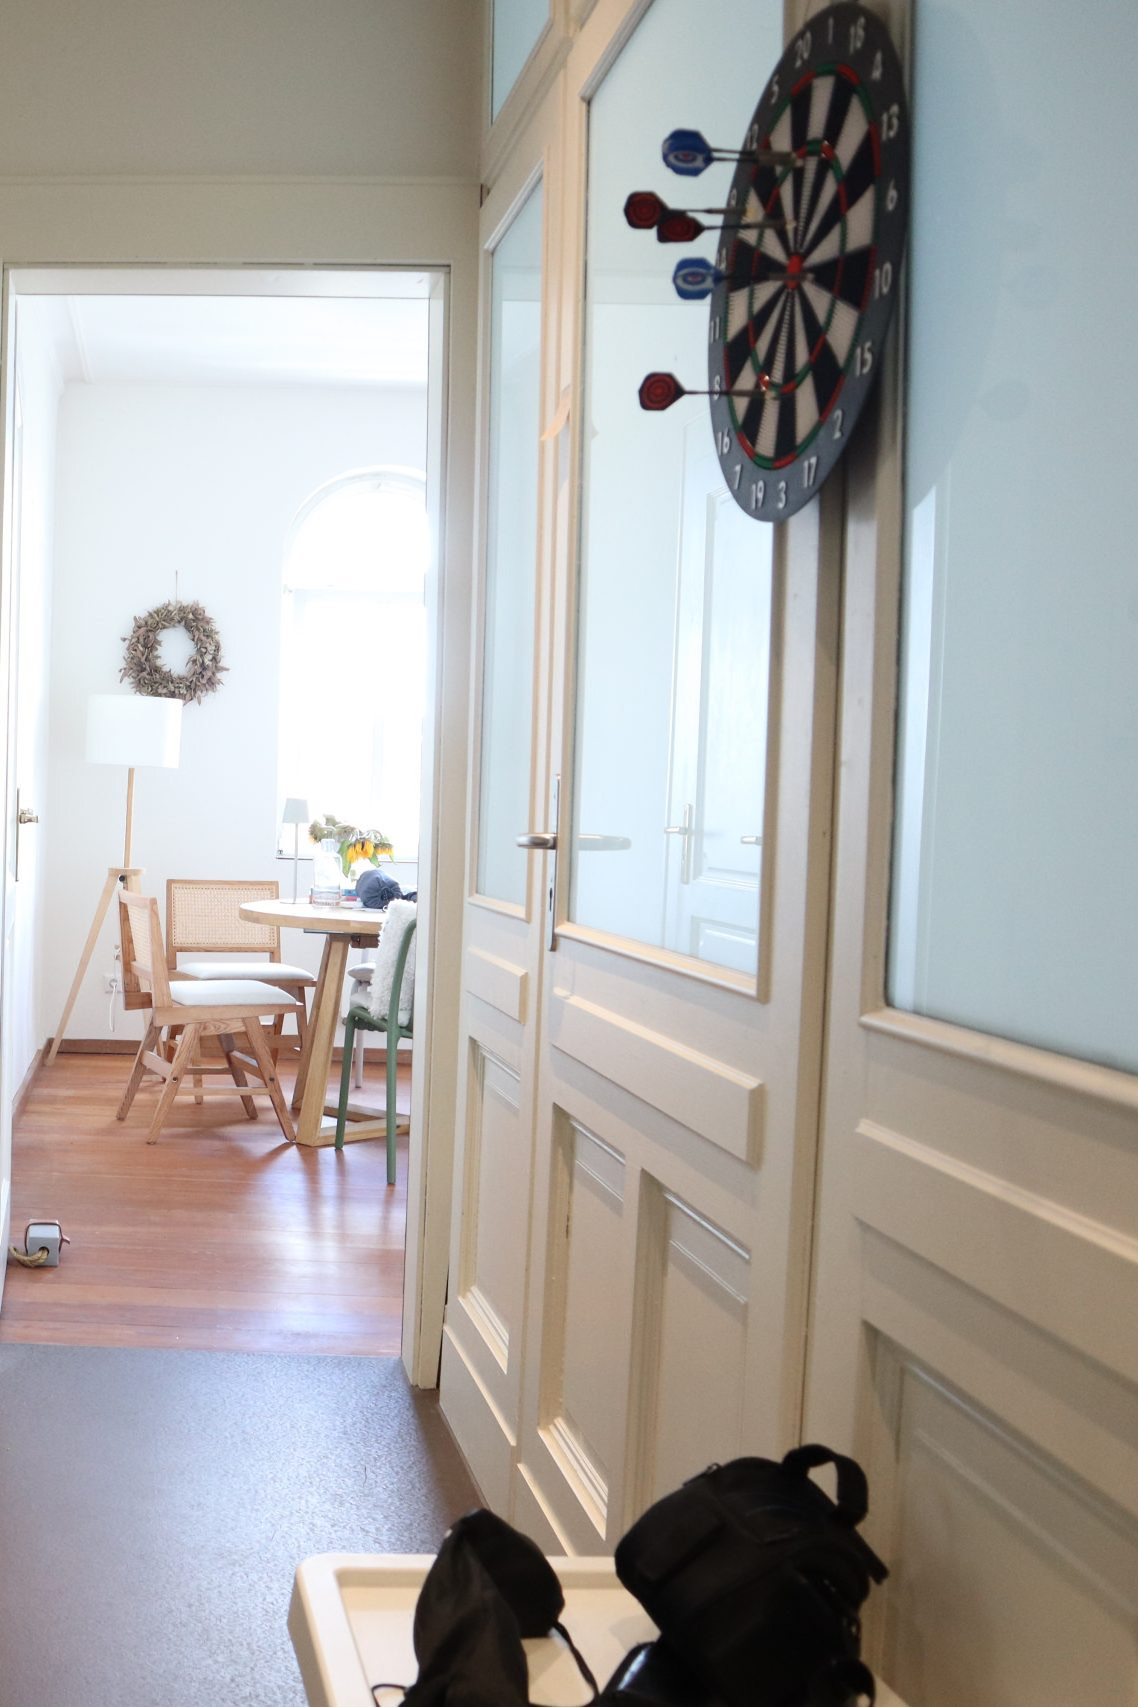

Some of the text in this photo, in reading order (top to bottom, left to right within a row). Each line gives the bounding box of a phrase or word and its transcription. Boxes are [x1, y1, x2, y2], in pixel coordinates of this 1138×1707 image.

[828, 16, 834, 44] 1
[795, 29, 812, 69] 20
[871, 50, 882, 80] 4
[771, 75, 779, 103] 5
[886, 178, 898, 211] 6
[874, 261, 892, 298] 10
[710, 316, 720, 344] 11
[856, 341, 872, 376] 15
[713, 374, 721, 400] 8
[833, 410, 843, 439] 2
[718, 428, 730, 455] 16
[734, 464, 742, 490] 7
[803, 456, 817, 488] 17
[752, 479, 764, 510] 19
[777, 480, 786, 508] 3
